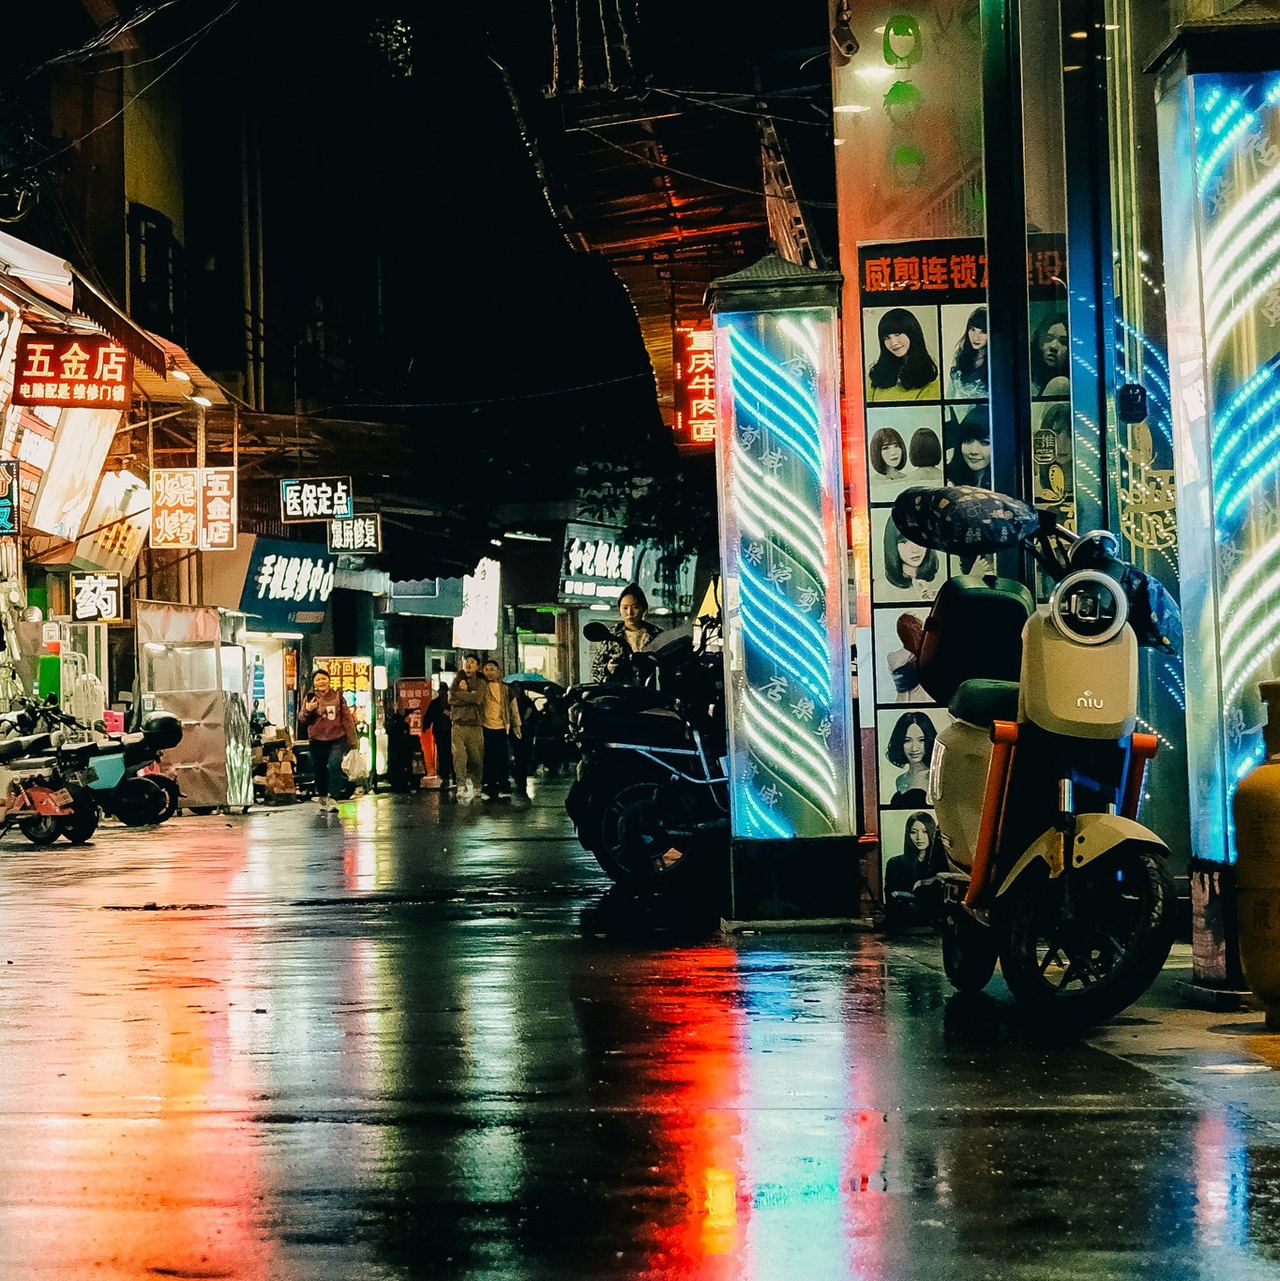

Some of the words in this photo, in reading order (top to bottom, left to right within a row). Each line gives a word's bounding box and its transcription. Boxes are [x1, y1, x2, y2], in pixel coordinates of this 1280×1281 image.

[23, 342, 127, 382] 五金店
[687, 330, 718, 442] 重庆牛肉面
[155, 472, 196, 544] 烧烤
[207, 474, 231, 544] 五金店
[286, 481, 350, 517] 医保定点
[331, 518, 377, 550] 爆屏修复
[74, 575, 119, 620] 药
[258, 554, 335, 603] 手机维修中心
